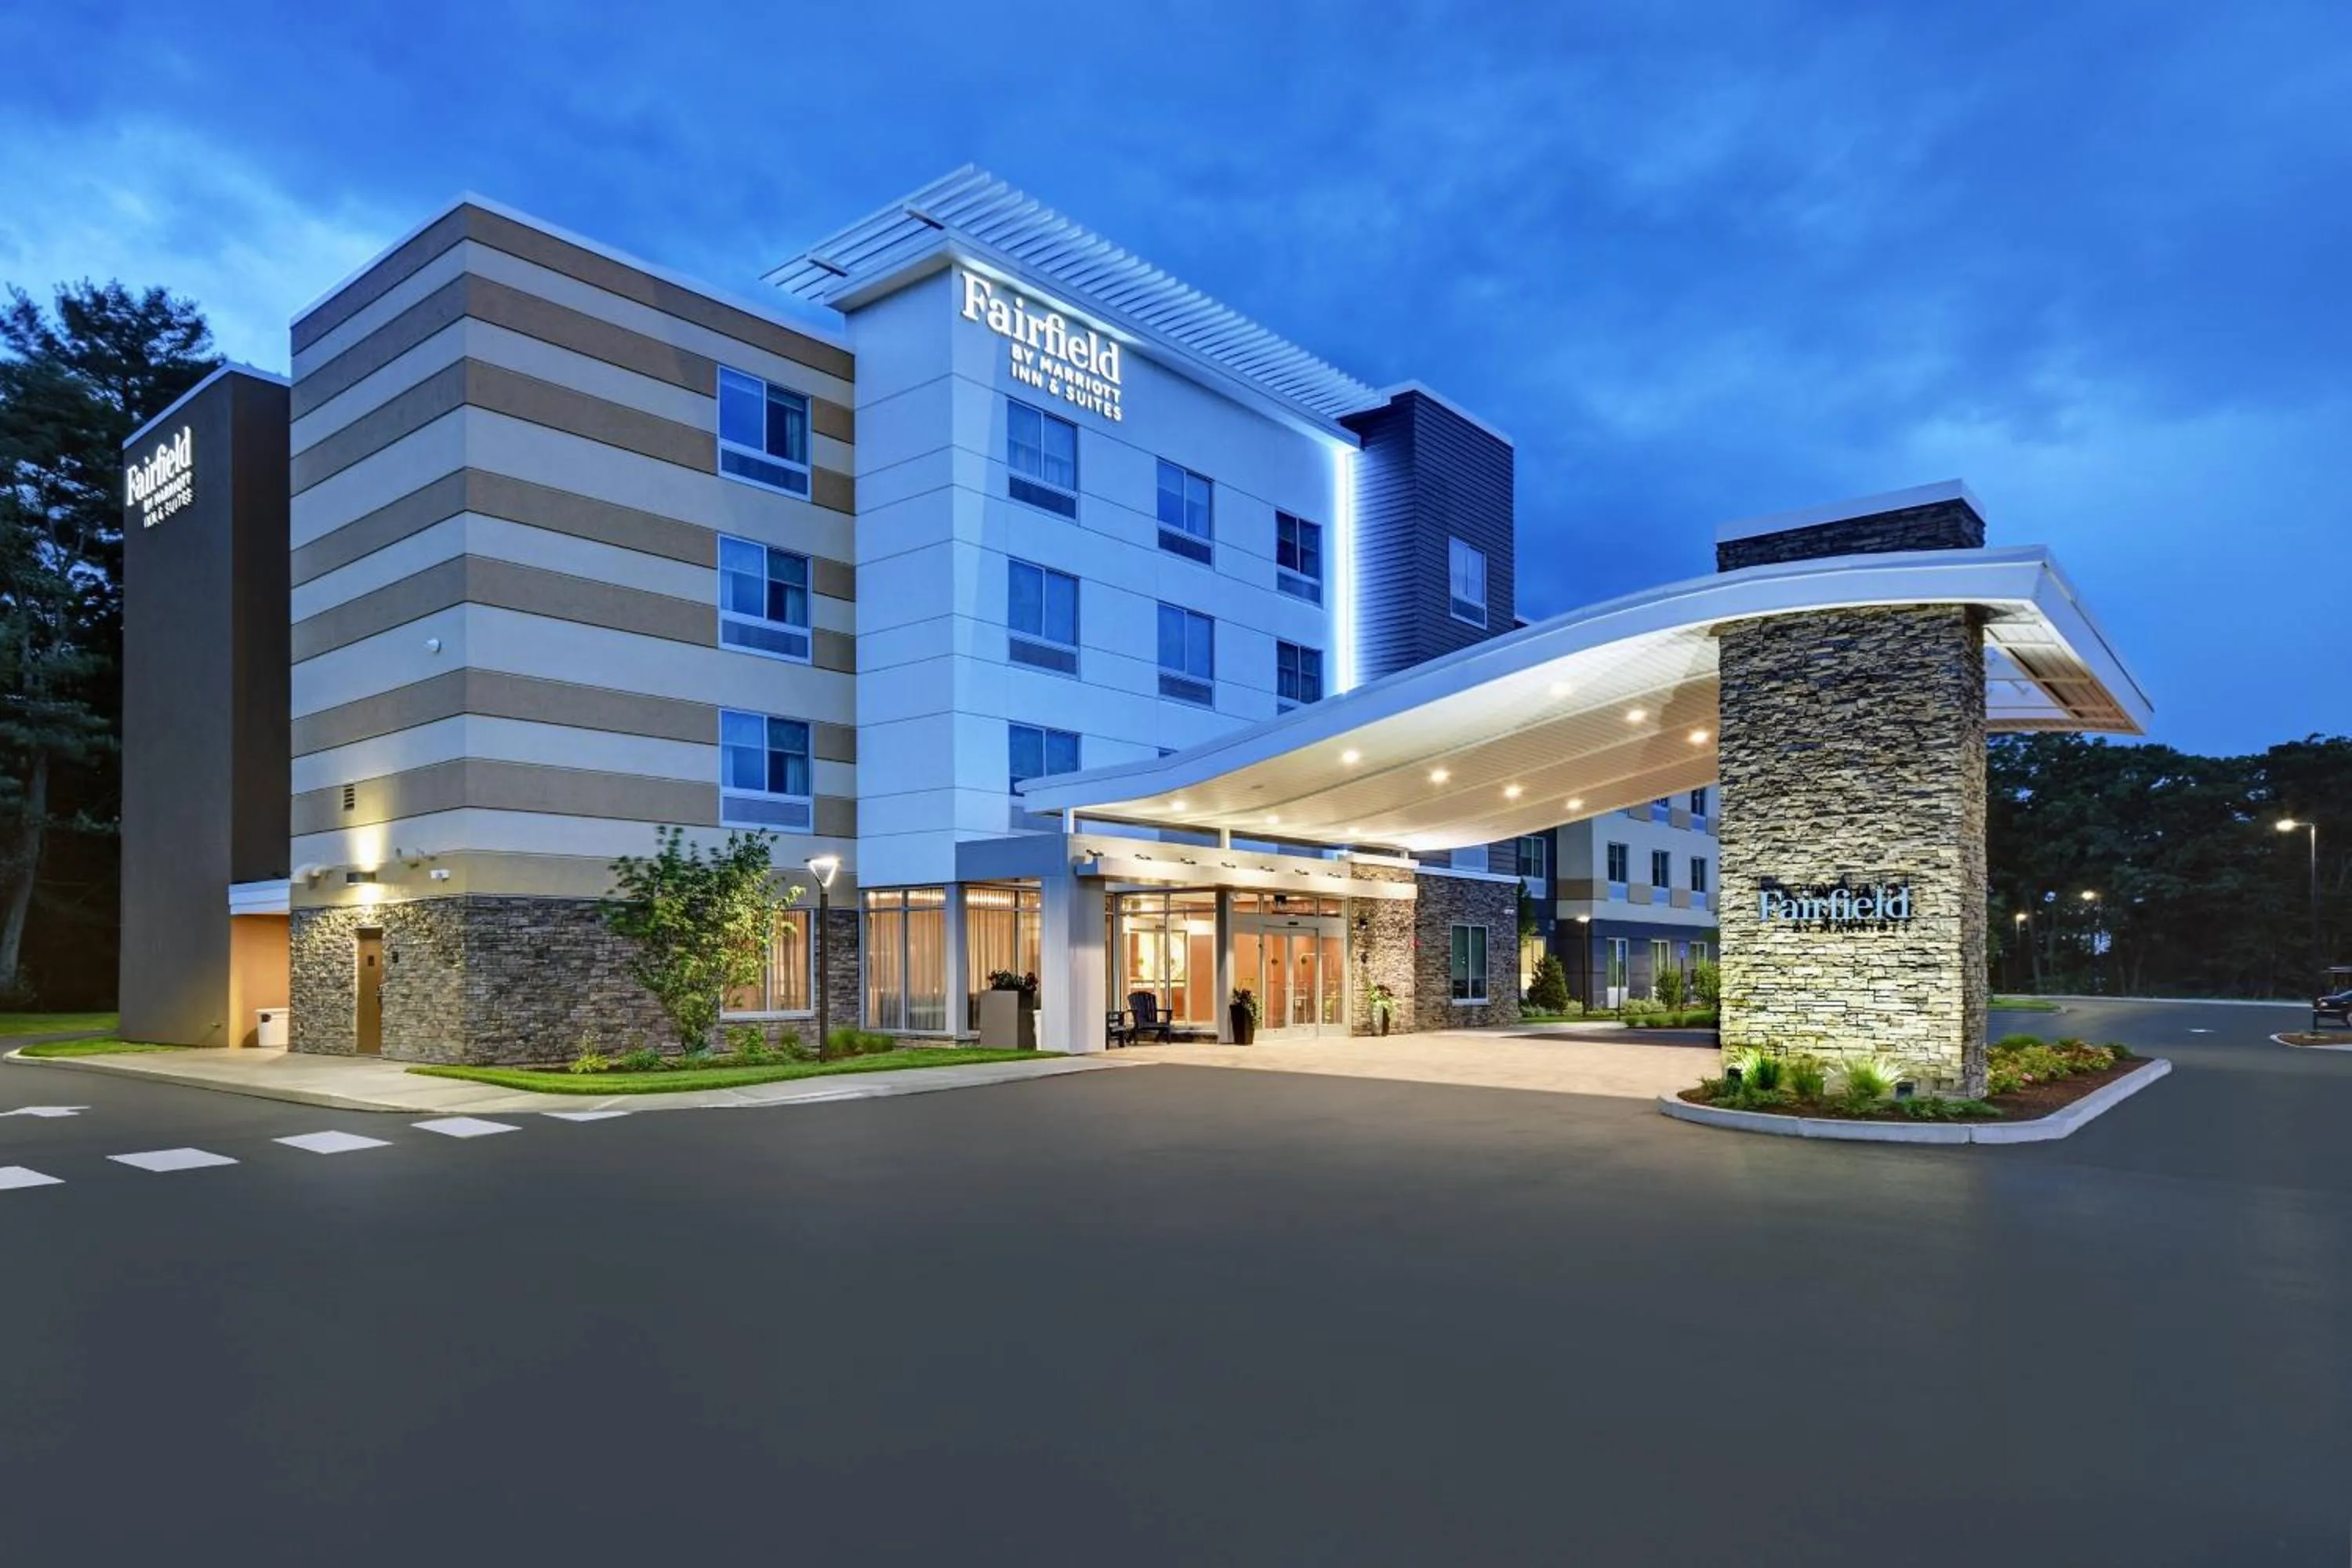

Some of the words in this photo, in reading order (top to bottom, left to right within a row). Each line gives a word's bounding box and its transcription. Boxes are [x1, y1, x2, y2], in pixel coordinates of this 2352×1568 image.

[962, 270, 1121, 384] Fairfield
[1011, 343, 1034, 365] BY
[1040, 355, 1121, 403] MARRIOTT
[1011, 361, 1042, 387] INN
[1049, 378, 1059, 394] &
[1065, 386, 1122, 421] SUITES
[126, 426, 192, 506] Fairfield
[1759, 885, 1911, 921] Fairfield
